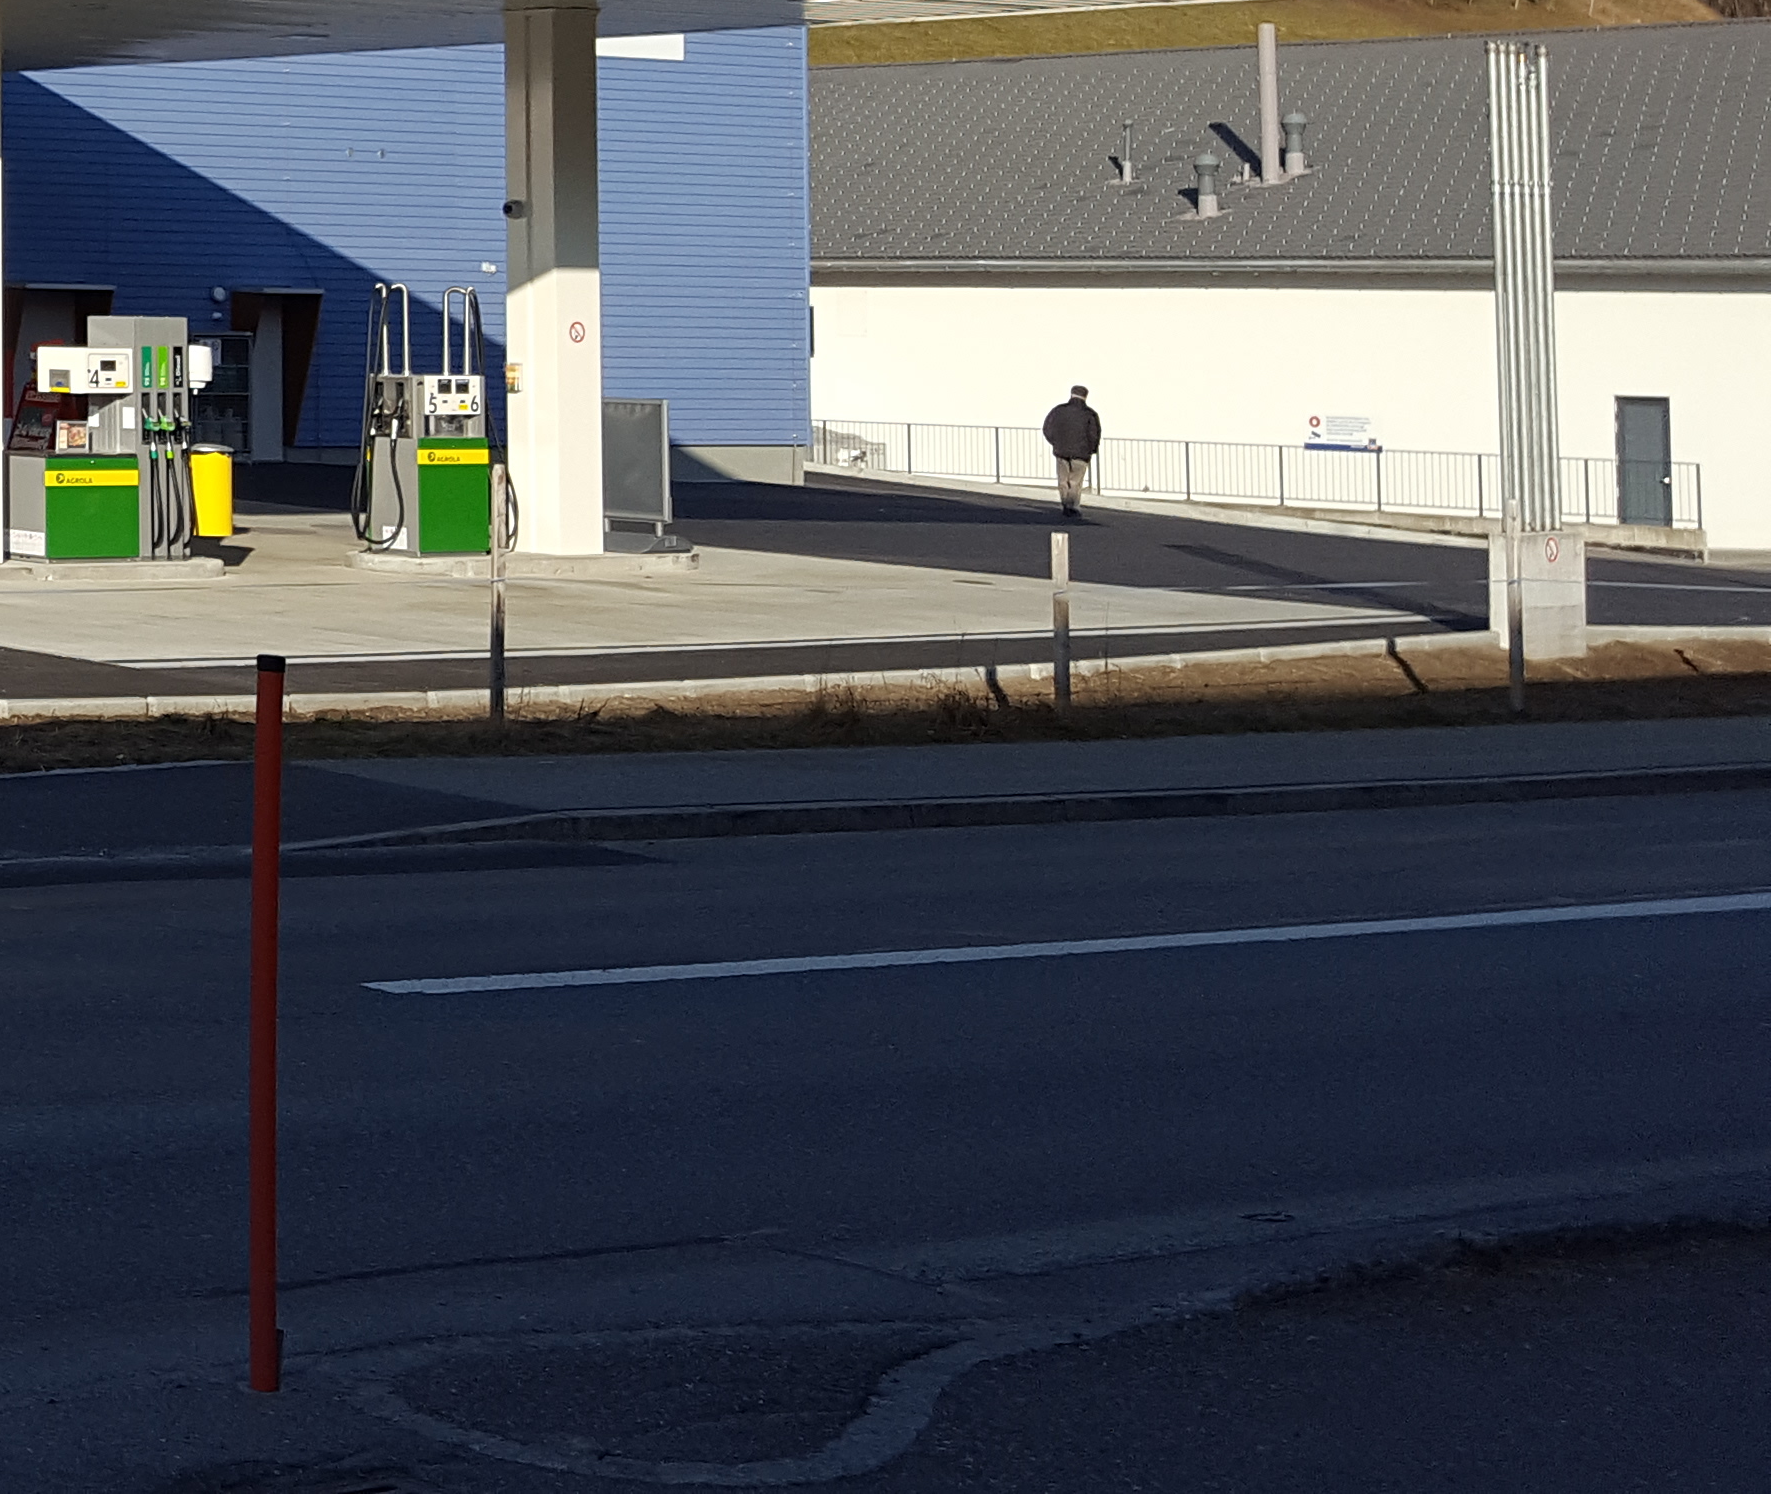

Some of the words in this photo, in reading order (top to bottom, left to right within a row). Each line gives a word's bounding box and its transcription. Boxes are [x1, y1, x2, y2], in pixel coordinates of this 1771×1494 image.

[89, 369, 100, 388] 4
[428, 395, 438, 414] 5
[470, 395, 480, 412] 6
